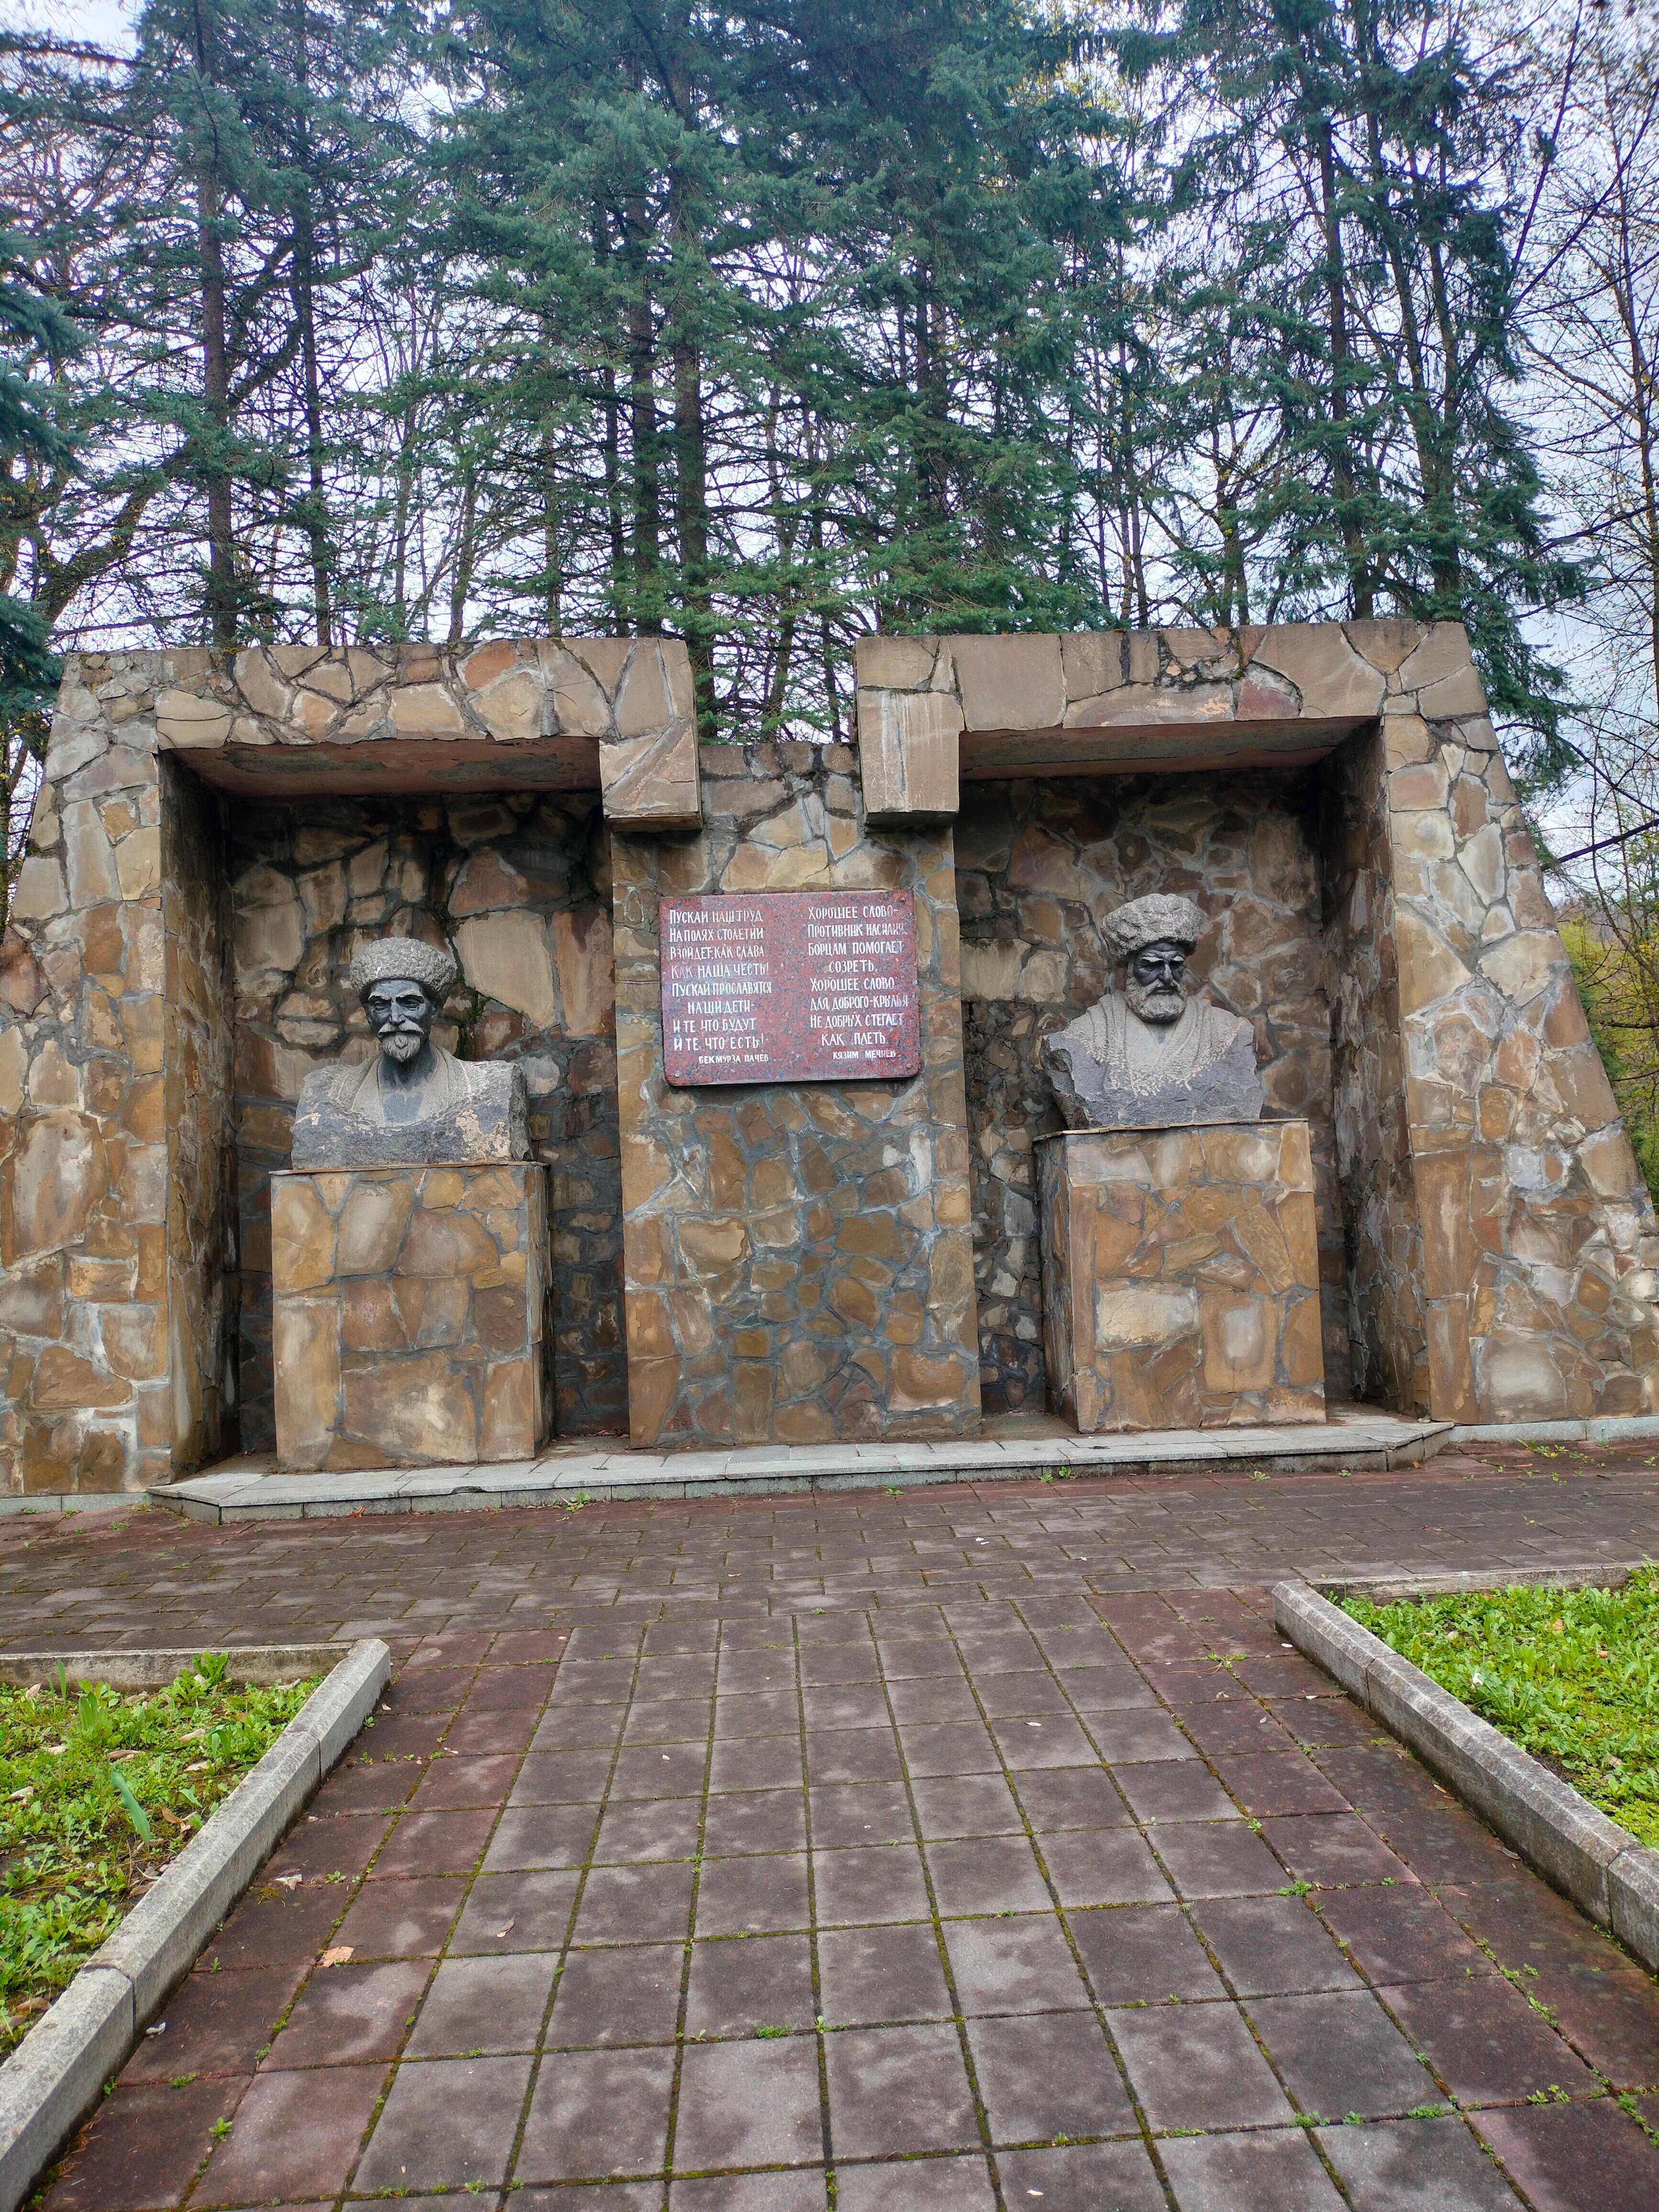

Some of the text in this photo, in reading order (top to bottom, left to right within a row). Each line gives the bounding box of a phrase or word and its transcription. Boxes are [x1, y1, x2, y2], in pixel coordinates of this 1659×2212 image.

[713, 910, 734, 923] НАШ
[736, 910, 763, 922] ТРУД
[808, 907, 858, 919] ХОРОШЕЕ
[670, 928, 683, 942] НА
[685, 929, 714, 941] ПОЛЯХ
[807, 924, 863, 938] ПРОТИВНИК
[714, 946, 733, 959] КАК
[736, 945, 764, 959] СЛАВА
[808, 941, 903, 956] БОРЦАМ ПОМОГАЕТ
[672, 962, 769, 979] КАК НАША ЧЕСТЬ!
[672, 981, 772, 997] ПУСКАЙ ПРОСЛАВЯТСЯ
[810, 977, 895, 991] ХОРОШЕЕ СЛОВО
[688, 1001, 721, 1014] НАШИ
[674, 1018, 757, 1033] И ТЕ ЧТО БУДУТ
[810, 1013, 904, 1029] НЕ ДОБРЫХ СТЕГАЕТ
[674, 1033, 763, 1051] И ТЕ ЧТО ЕСТЬ!
[822, 1032, 885, 1046] КАК ПЛЕТЬ
[698, 1055, 741, 1064] БЕКМУРЗА
[833, 1051, 858, 1059] КЯЗИМ
